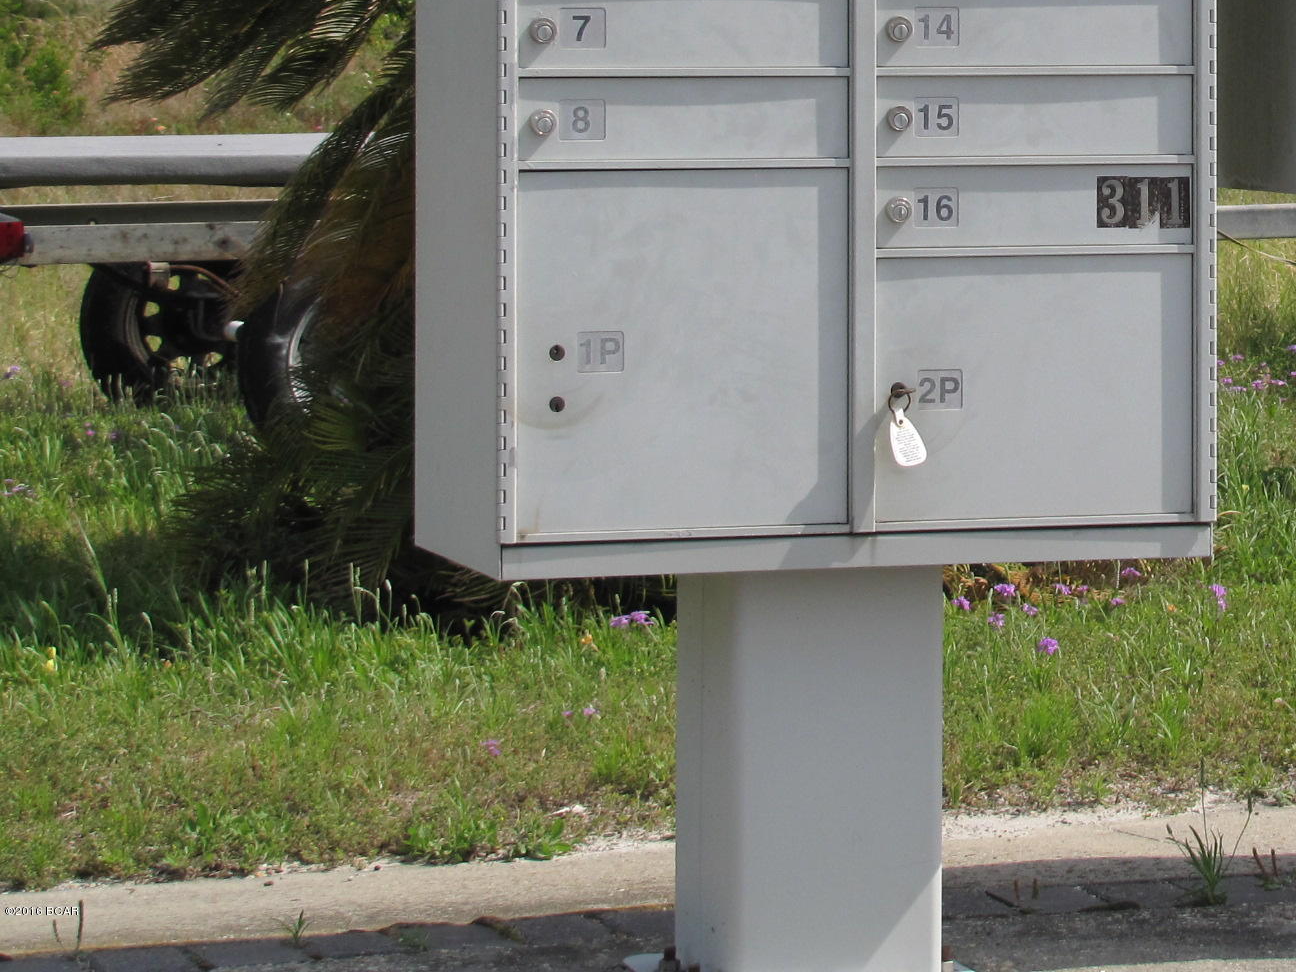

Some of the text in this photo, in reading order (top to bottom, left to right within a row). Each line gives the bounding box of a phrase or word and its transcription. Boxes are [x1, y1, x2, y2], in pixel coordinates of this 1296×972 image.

[571, 15, 592, 42] 7
[917, 15, 955, 41] 14
[571, 106, 591, 133] 8
[917, 104, 955, 131] 15
[917, 195, 954, 222] 16
[1101, 179, 1187, 226] 311
[579, 338, 621, 365] 1P
[918, 377, 960, 404] 2P
